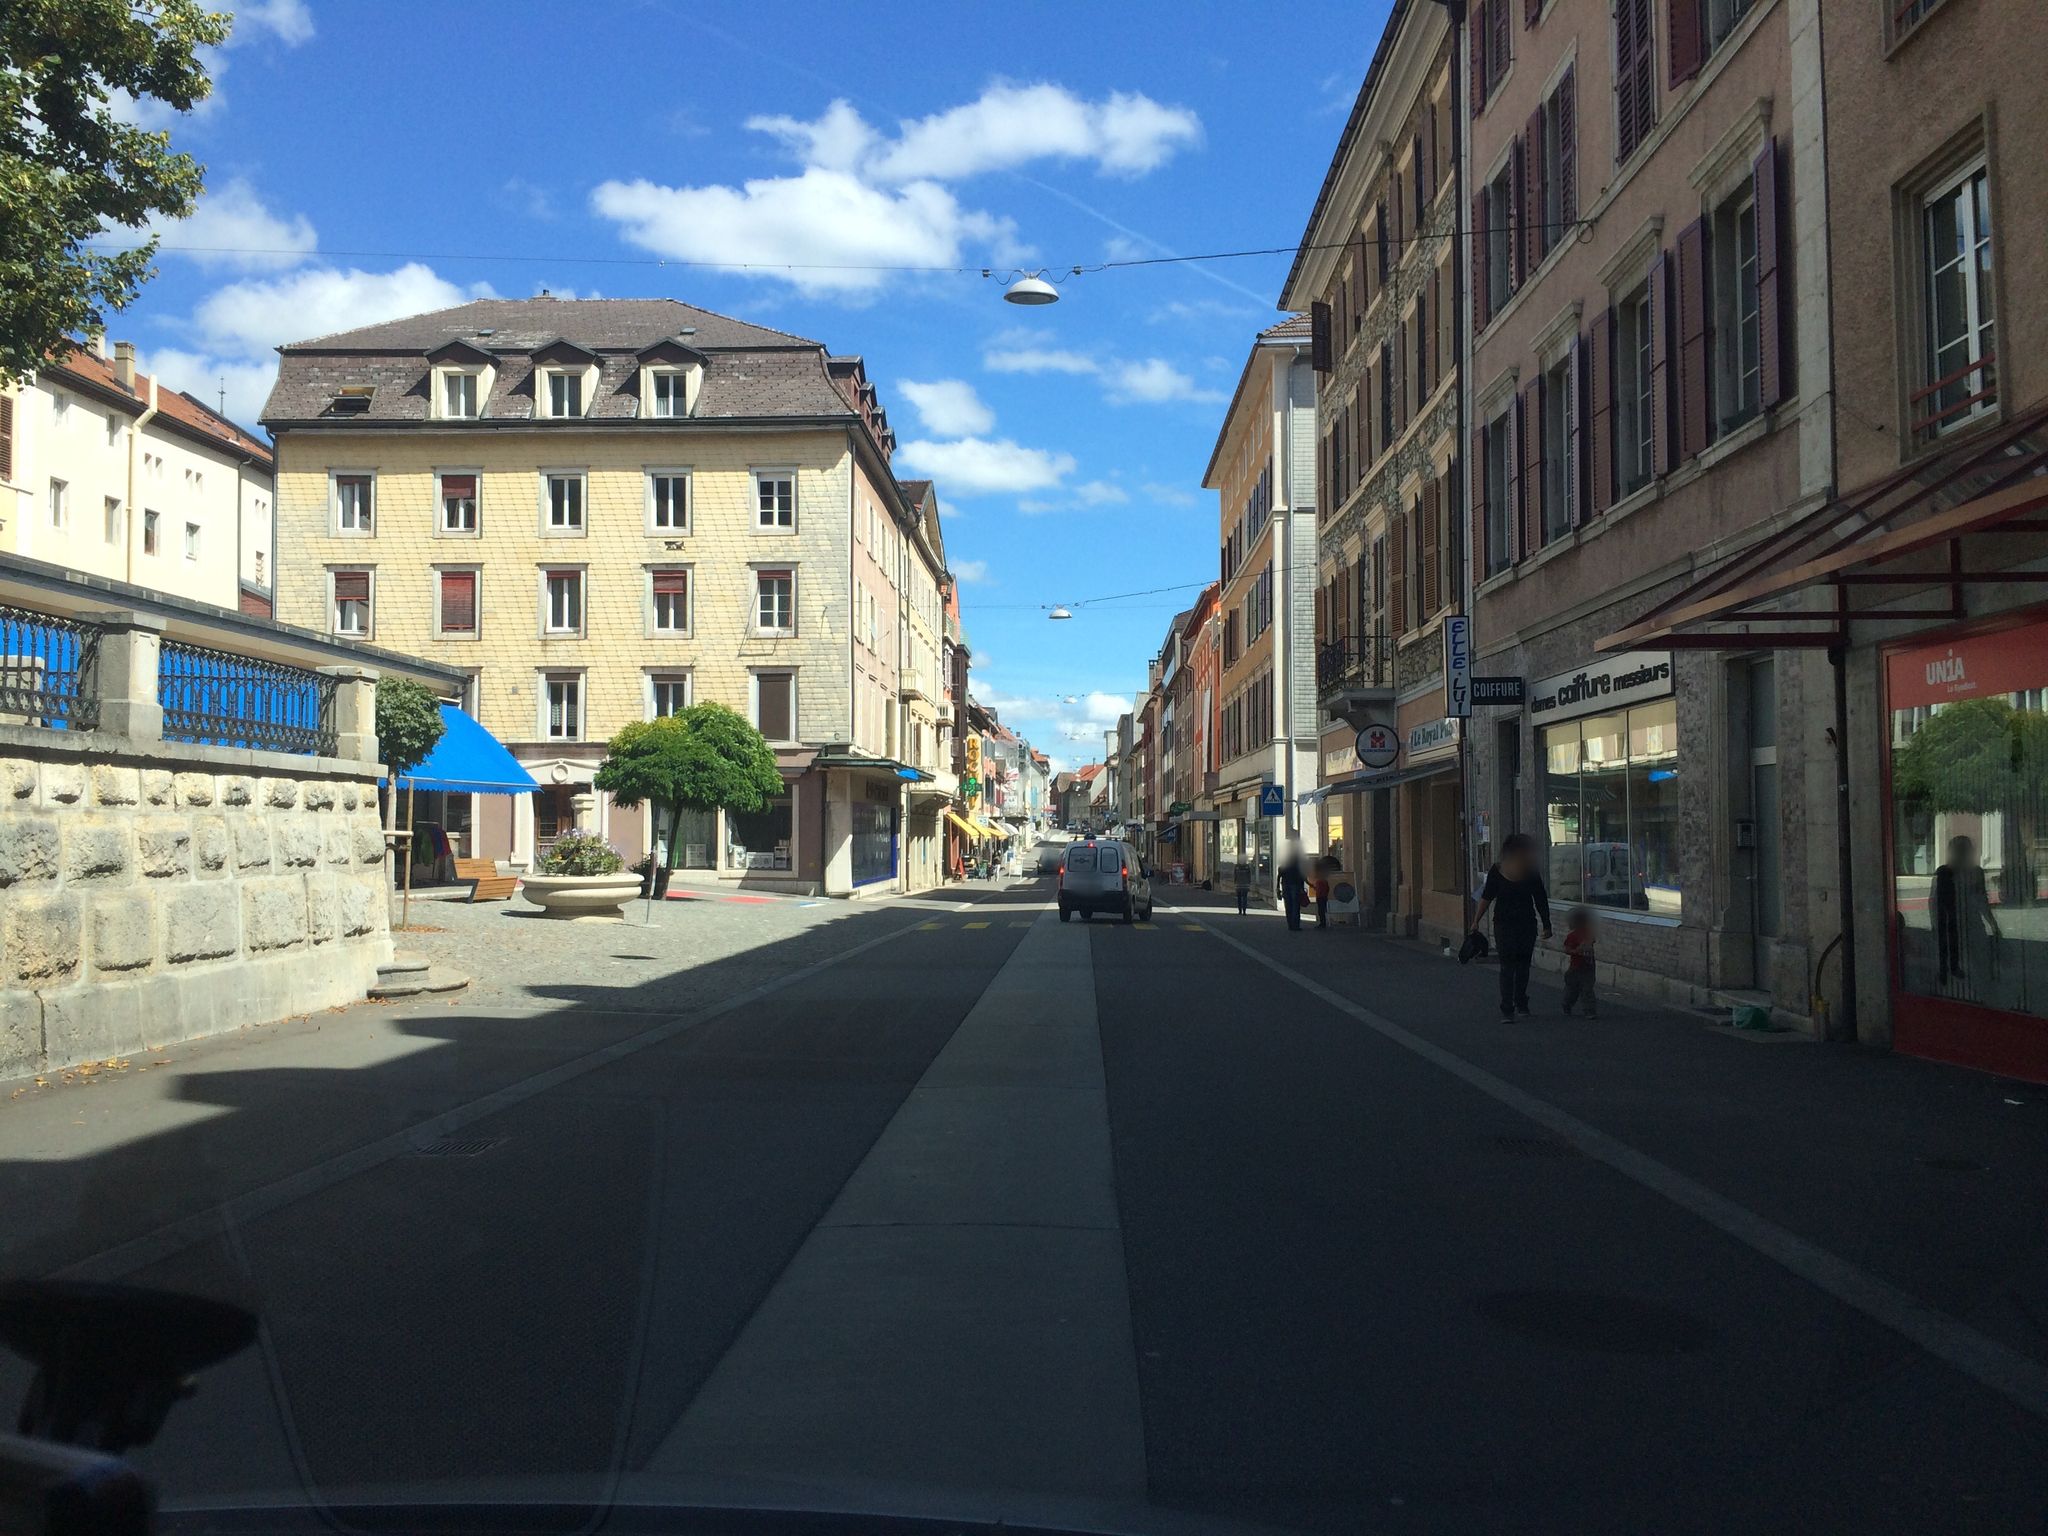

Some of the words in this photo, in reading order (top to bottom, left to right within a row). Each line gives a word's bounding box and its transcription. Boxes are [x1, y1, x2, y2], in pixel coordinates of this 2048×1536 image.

[1473, 681, 1521, 698] COIFFURE
[1558, 672, 1611, 706] coiffure
[1613, 662, 1670, 692] messieurs
[1422, 724, 1439, 746] Royal
